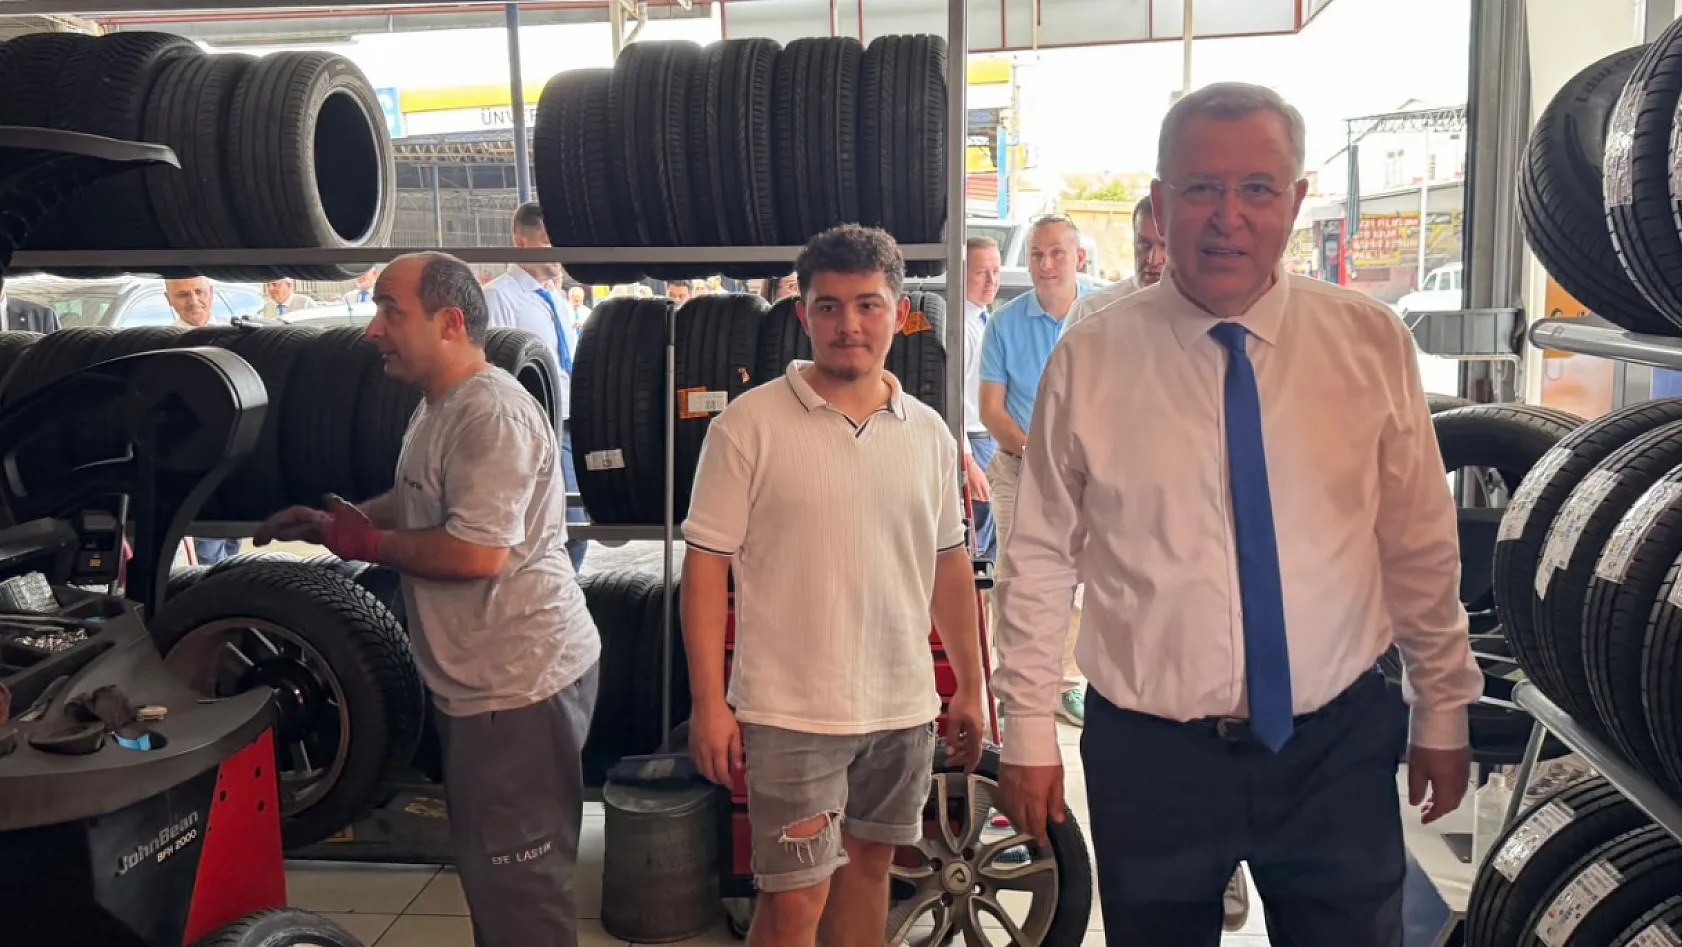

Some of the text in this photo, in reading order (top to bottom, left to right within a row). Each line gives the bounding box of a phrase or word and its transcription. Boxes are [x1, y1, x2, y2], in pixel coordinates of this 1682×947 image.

[118, 811, 199, 875] JohnBean
[175, 828, 197, 850] 2000
[492, 855, 511, 865] EFE
